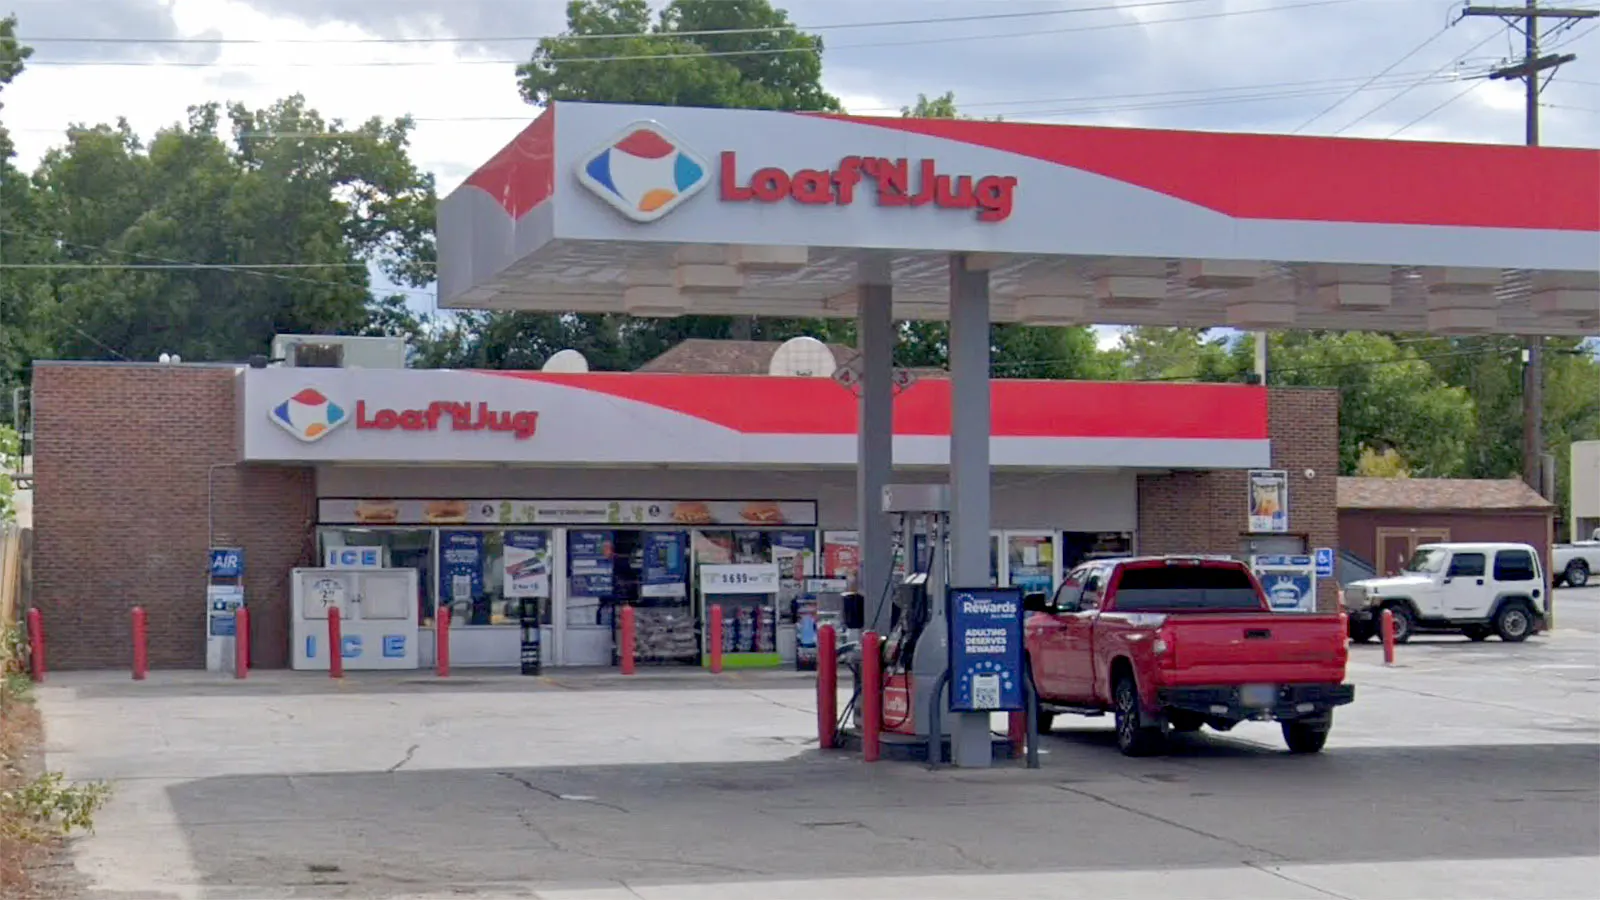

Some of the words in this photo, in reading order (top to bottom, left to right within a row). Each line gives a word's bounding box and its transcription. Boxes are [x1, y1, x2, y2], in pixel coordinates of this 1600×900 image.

[720, 151, 861, 206] Loaf
[905, 158, 1017, 223] Jug
[356, 400, 440, 431] Loaf
[469, 401, 539, 441] Jug
[213, 555, 238, 569] AIR
[330, 549, 378, 566] ICE
[963, 601, 1017, 614] Rewards
[965, 628, 1007, 636] ADULTING
[306, 634, 407, 659] ICE
[965, 637, 1008, 645] DESERVES
[965, 645, 1007, 653] REWARDS
